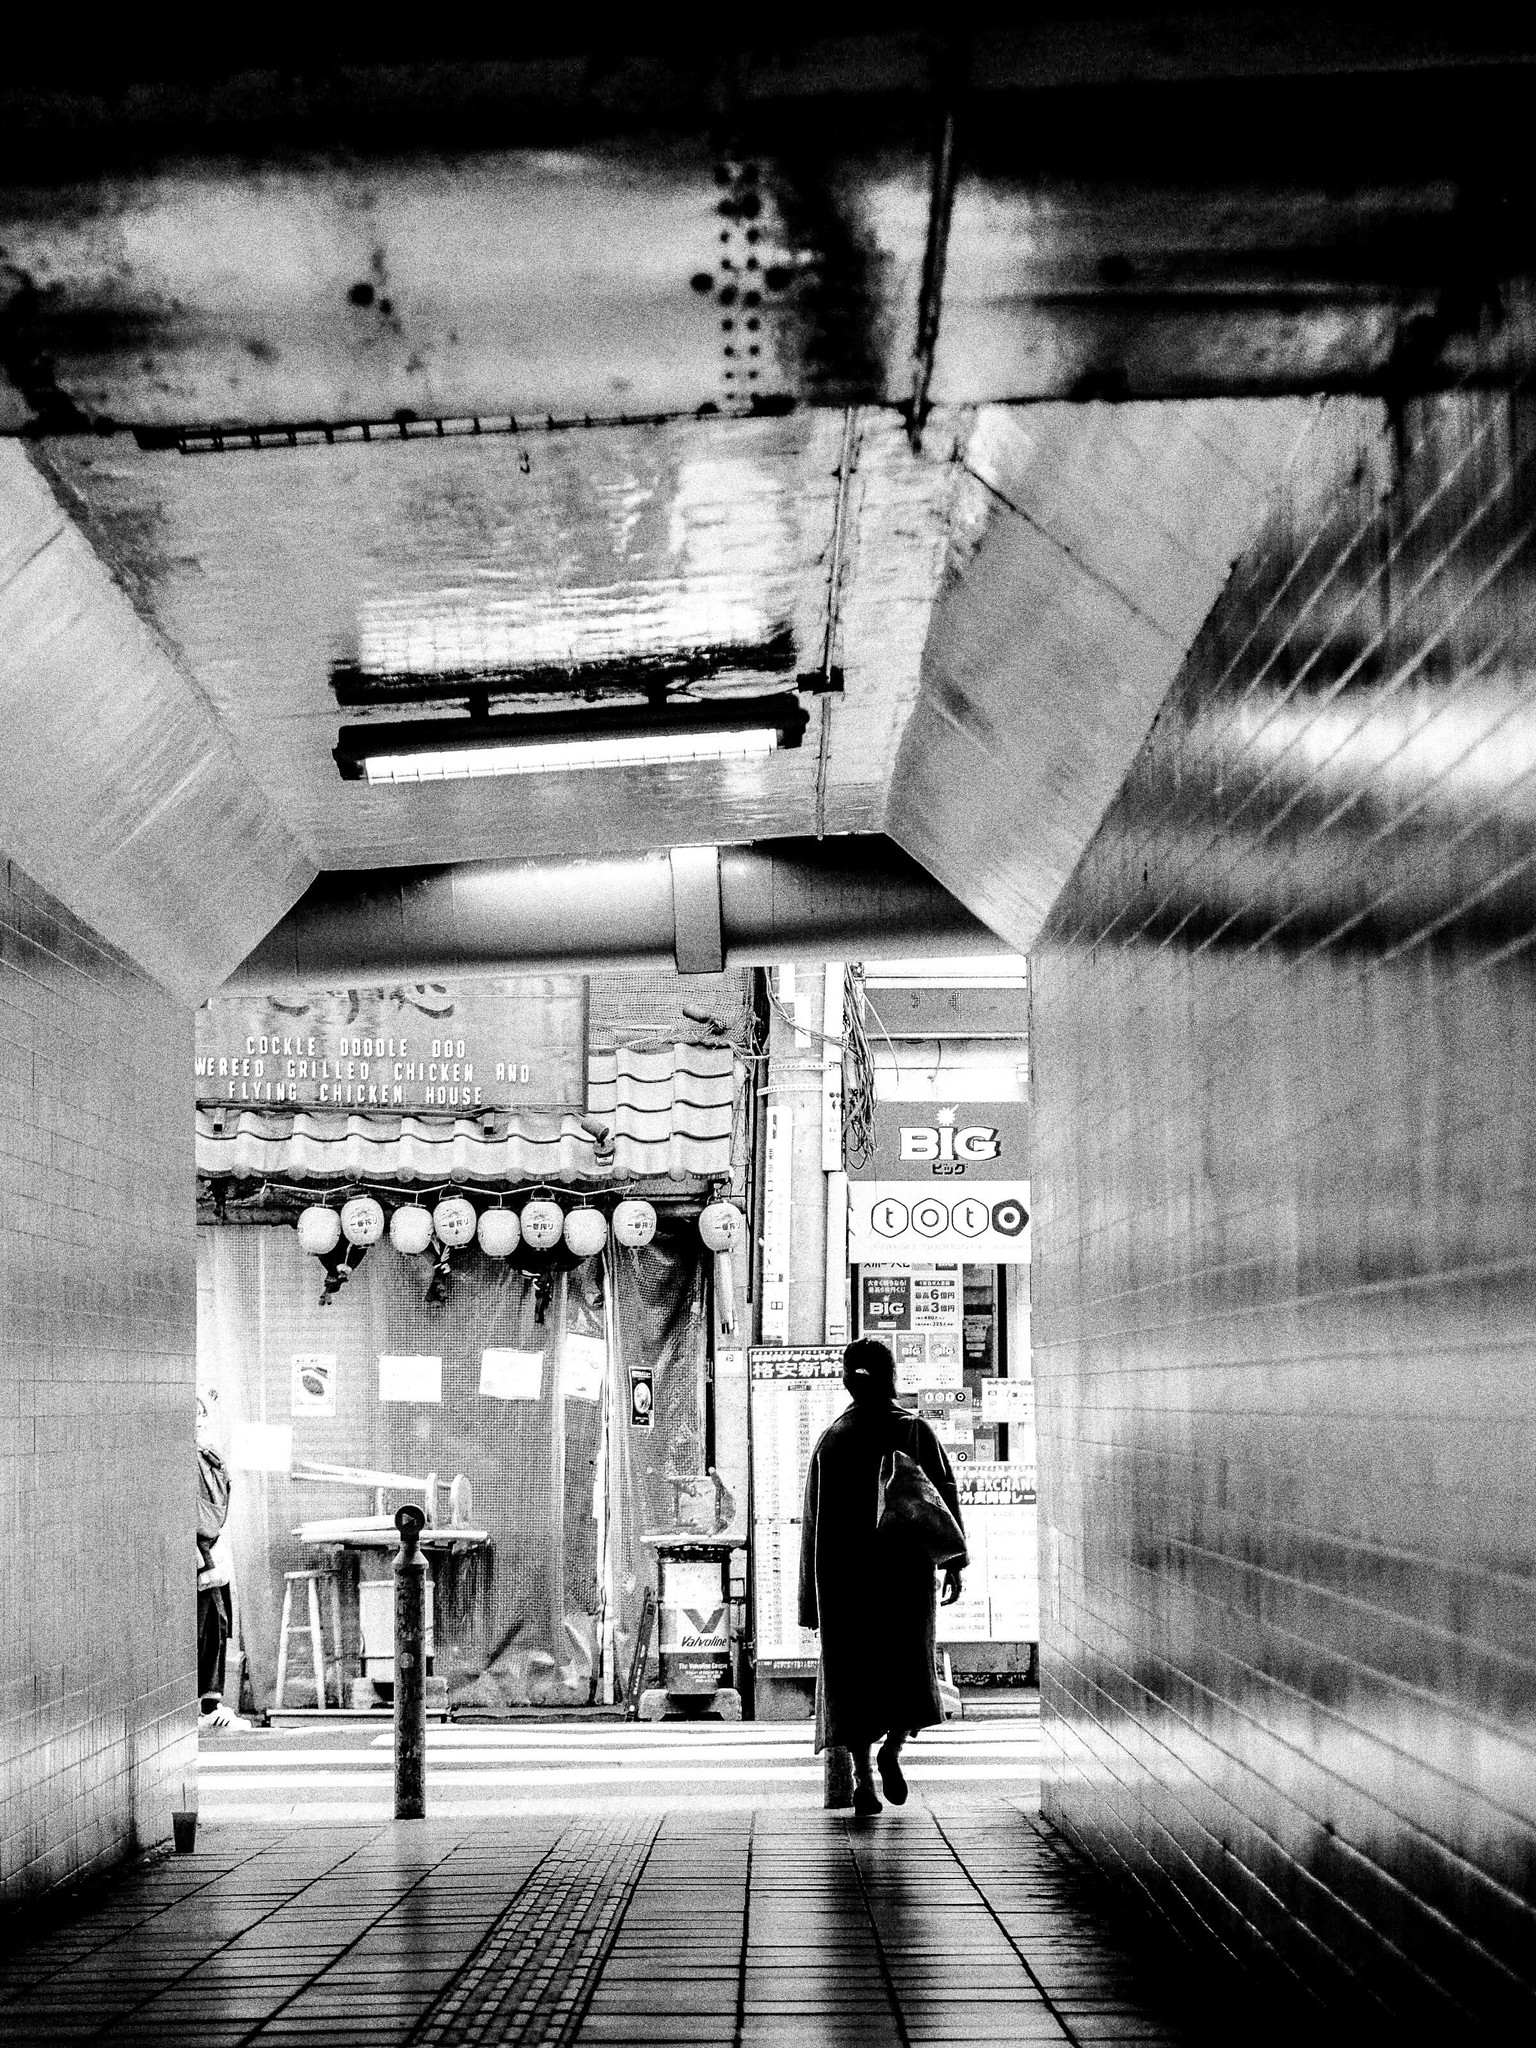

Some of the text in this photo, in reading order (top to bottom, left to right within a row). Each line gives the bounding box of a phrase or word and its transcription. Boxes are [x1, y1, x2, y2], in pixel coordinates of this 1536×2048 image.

[246, 1036, 466, 1058] COCKLE DOODLE DOO
[287, 1060, 370, 1081] GRILLED
[394, 1062, 474, 1083] CHICKEN
[496, 1063, 530, 1084] AND
[228, 1081, 483, 1106] FLYING CHICKEN HOUSE
[898, 1125, 1001, 1162] BIG
[931, 1163, 969, 1176] ビッグ
[872, 1198, 1029, 1238] toto
[869, 1301, 906, 1315] BIG
[681, 1635, 728, 1648] Valvoline
